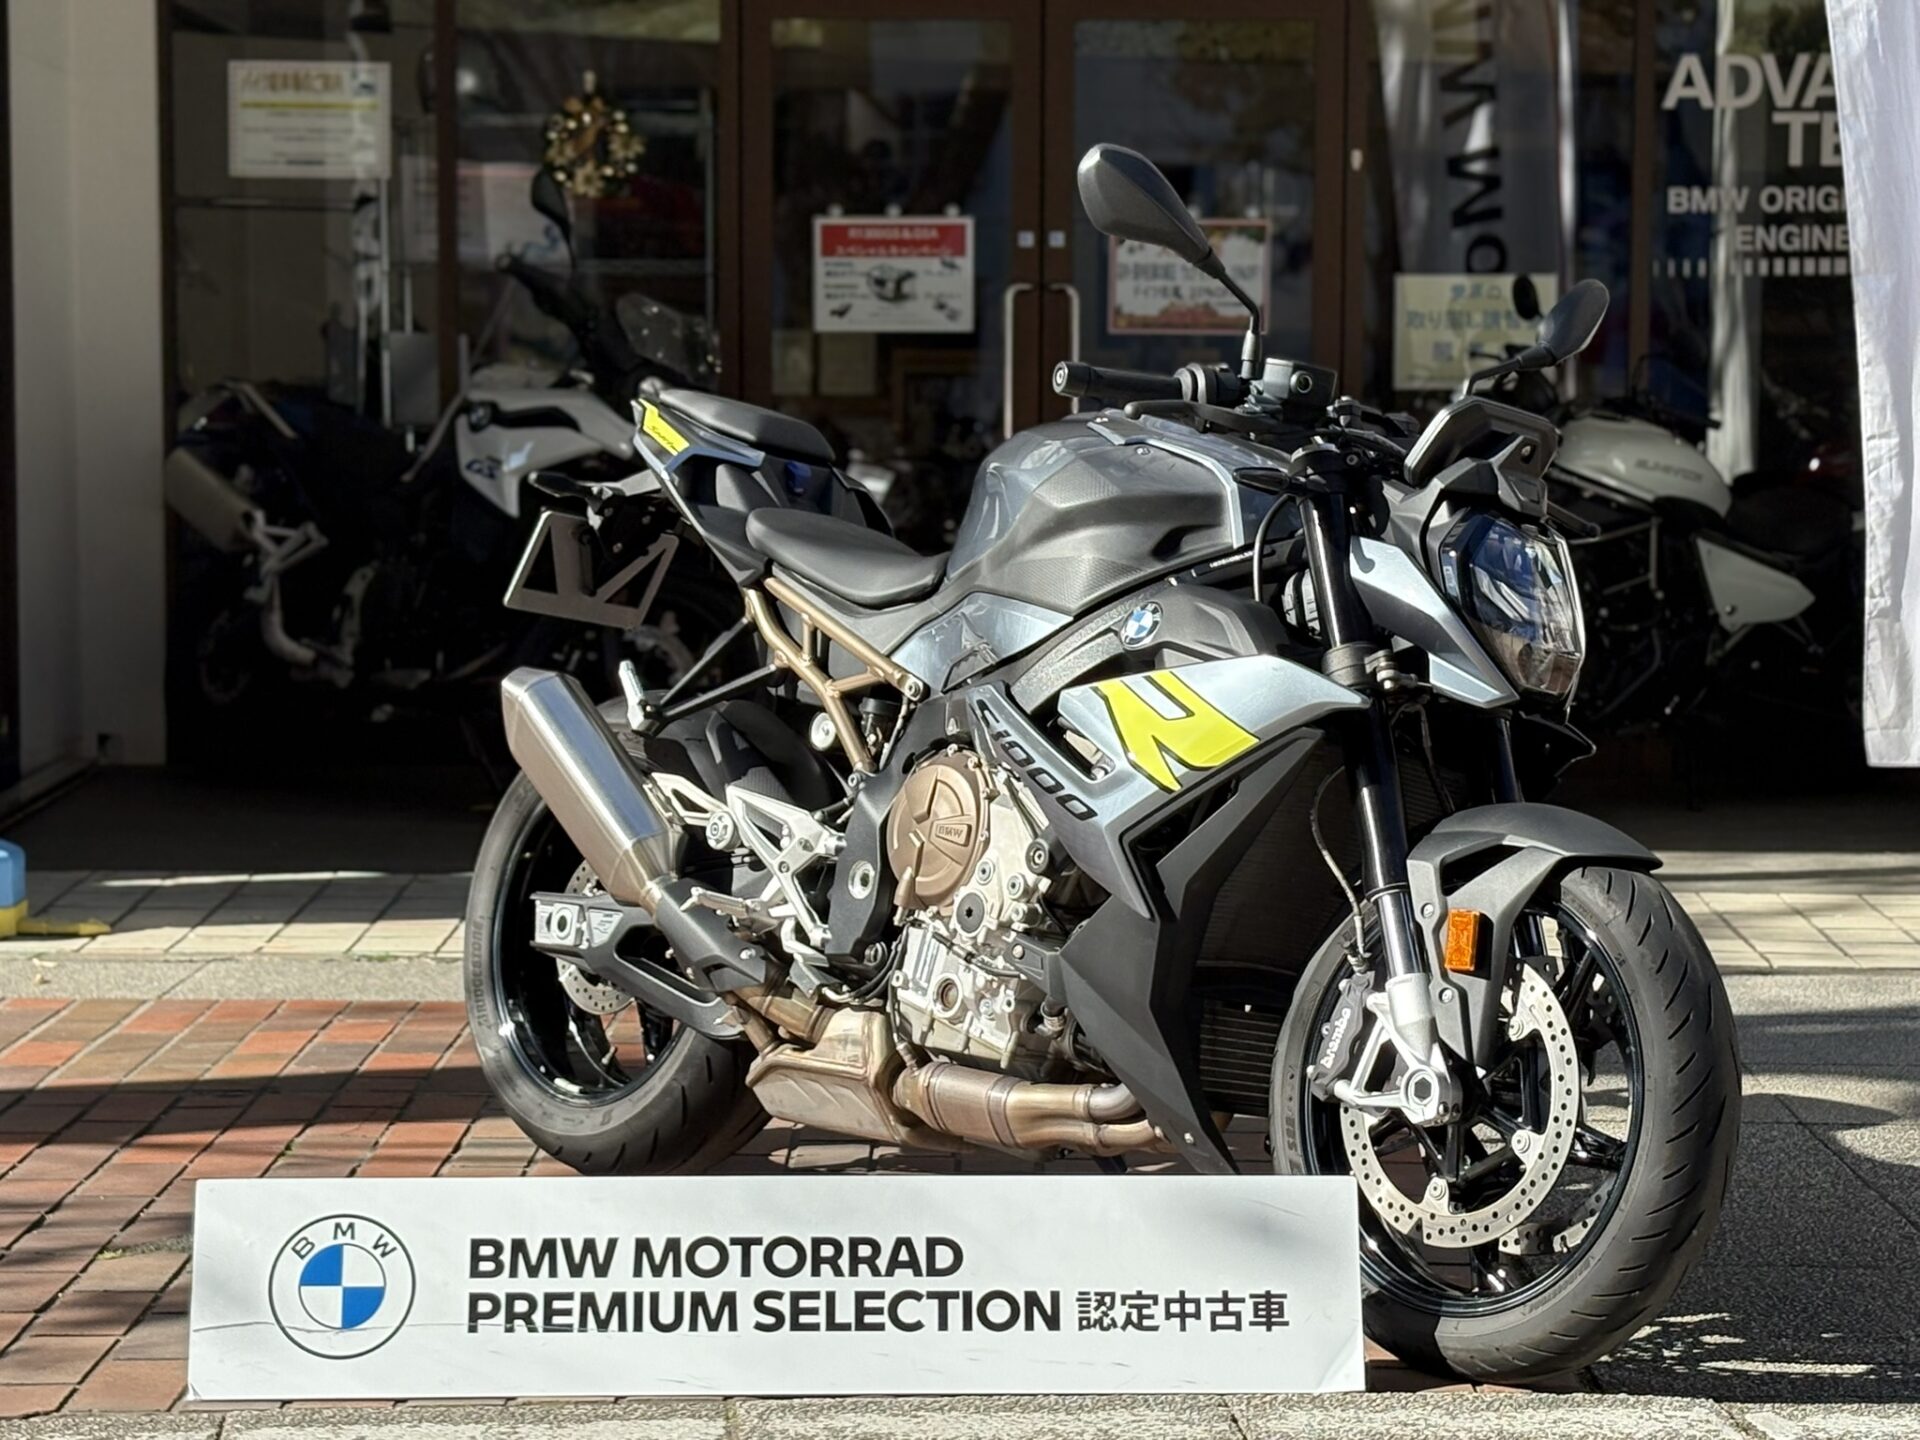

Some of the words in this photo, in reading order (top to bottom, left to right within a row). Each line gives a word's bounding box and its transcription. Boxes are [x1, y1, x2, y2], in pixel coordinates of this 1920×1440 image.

[1667, 185, 1749, 214] BMW
[1736, 223, 1850, 252] ENGINE
[938, 825, 964, 839] BMW
[1320, 1007, 1351, 1069] brembo
[291, 1222, 398, 1260] BMW
[469, 1237, 618, 1279] BMW
[633, 1236, 964, 1279] MOTORRAD
[468, 1291, 738, 1333] PREMIUM
[753, 1290, 1061, 1333] SELECTION
[1076, 1290, 1290, 1332] 認定中古車
